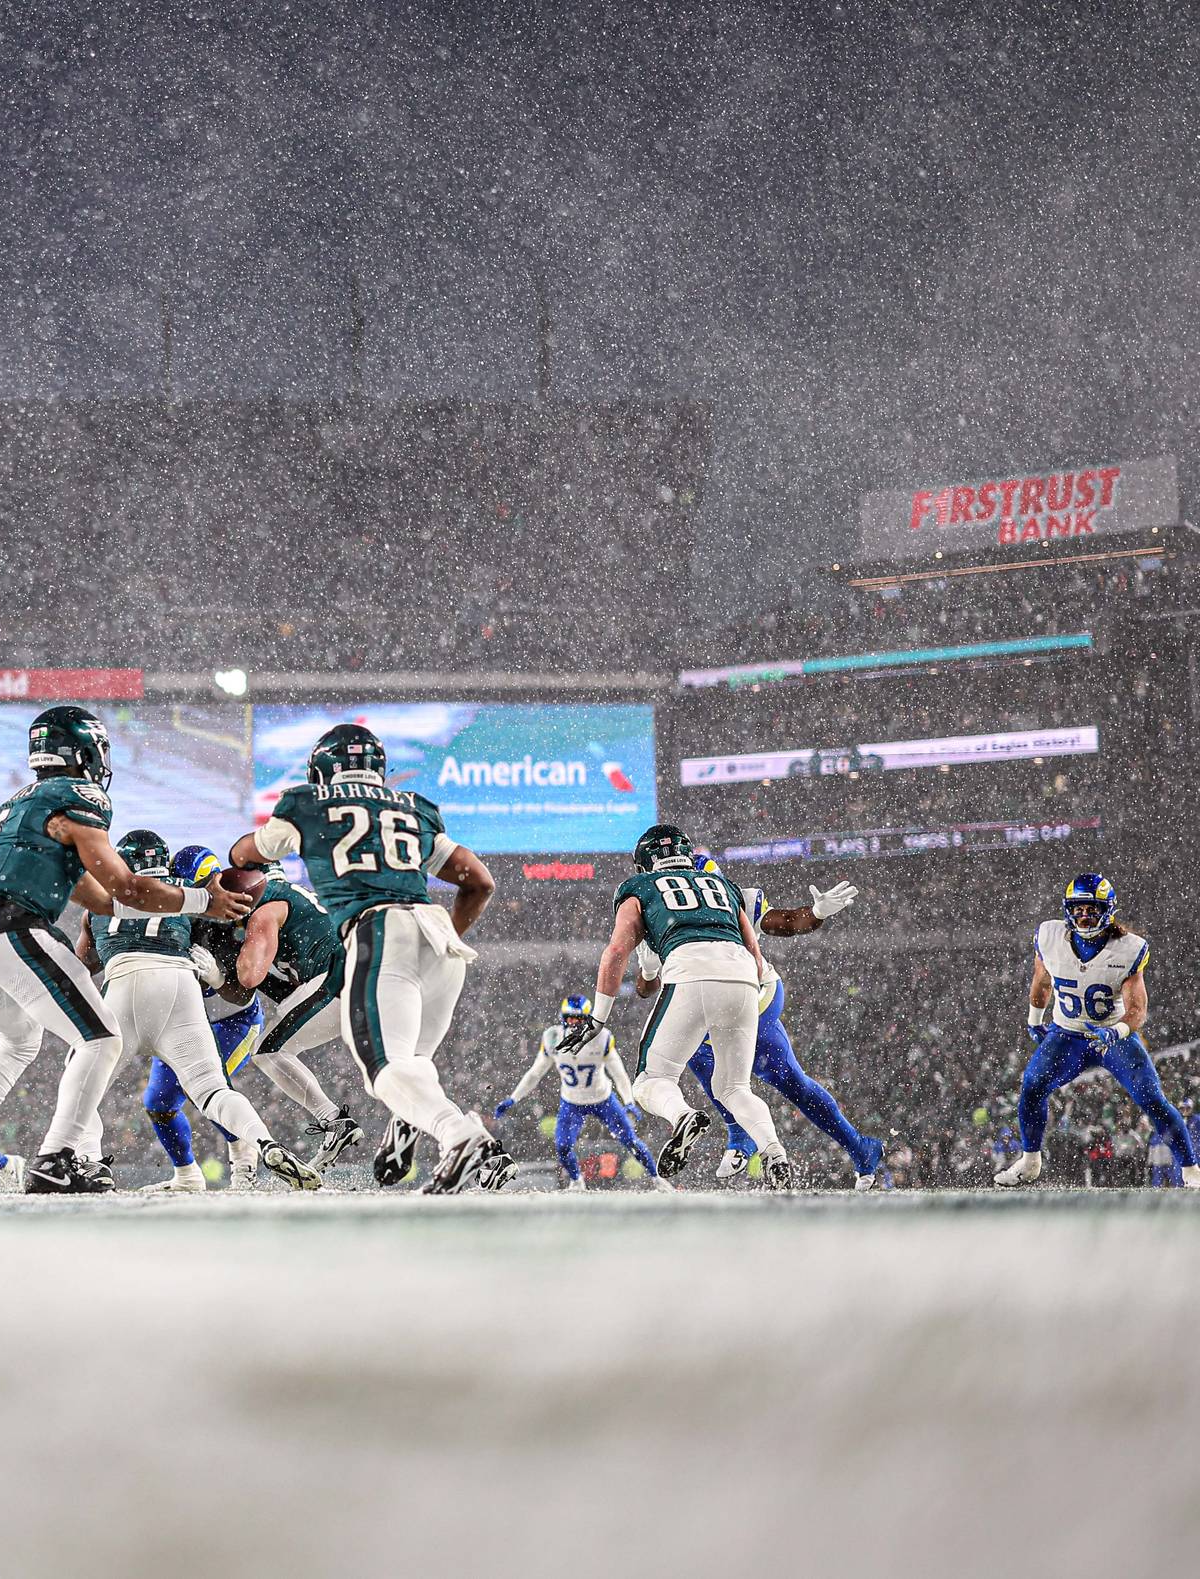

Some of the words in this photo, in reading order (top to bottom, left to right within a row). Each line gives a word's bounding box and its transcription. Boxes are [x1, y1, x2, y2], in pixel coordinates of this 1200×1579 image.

[998, 509, 1097, 545] BANK
[437, 755, 587, 787] American
[317, 783, 416, 808] BARKLEY
[328, 805, 422, 878] 26
[654, 876, 733, 914] 88
[1053, 976, 1116, 1022] 56
[560, 1063, 596, 1088] 37
